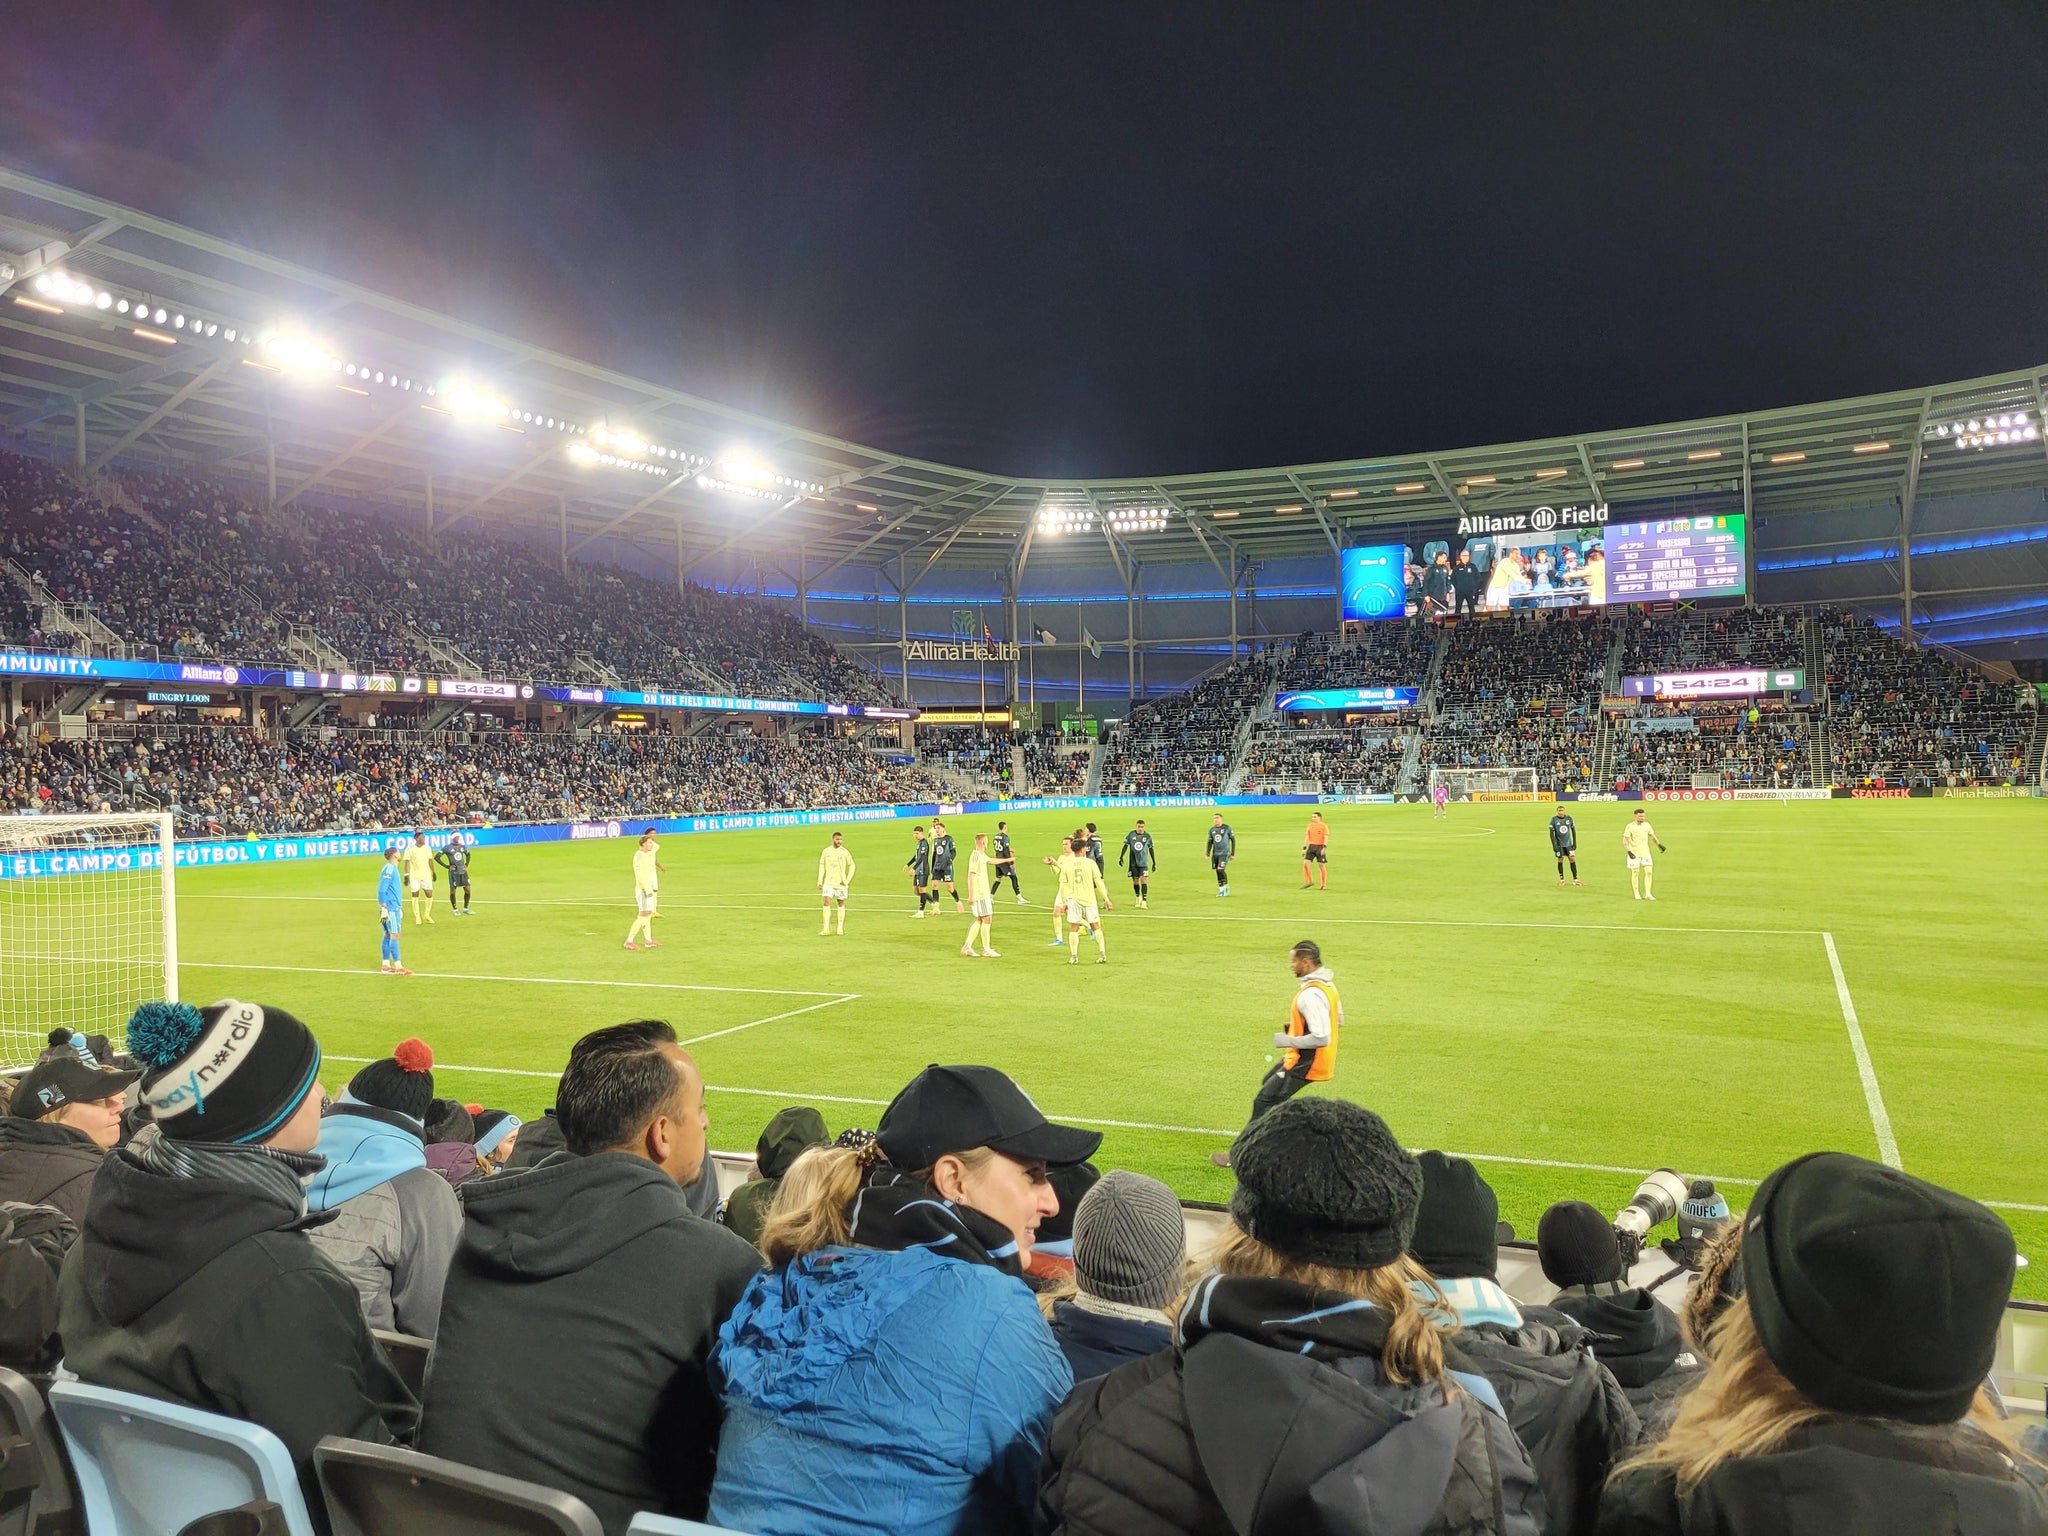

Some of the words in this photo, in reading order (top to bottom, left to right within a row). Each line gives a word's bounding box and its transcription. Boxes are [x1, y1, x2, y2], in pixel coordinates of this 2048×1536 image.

[1457, 514, 1527, 534] Allianz
[1561, 503, 1609, 525] Field
[908, 641, 962, 661] Allina
[182, 665, 223, 682] Allianz
[1634, 681, 1644, 693] 1
[1671, 678, 1750, 690] 54:24
[1775, 674, 1796, 687] 0
[455, 684, 507, 697] 54:24
[571, 690, 594, 701] Allianz
[148, 692, 185, 703] HUNGRY
[186, 693, 211, 703] LOON
[643, 694, 658, 704] ON
[660, 695, 677, 705] THE
[680, 695, 703, 707] FIELD
[705, 697, 722, 708] AND
[724, 698, 734, 708] IN
[735, 699, 752, 709] OUR
[753, 700, 801, 712] COMMUNITY.
[1480, 791, 1525, 802] Continental
[1577, 792, 1619, 803] Gillette
[1736, 792, 1776, 800] FEDERATED
[1776, 790, 1821, 799] INSURANCE
[1851, 788, 1911, 799] SEATGEEK
[1943, 788, 1976, 799] Allina
[1976, 787, 2015, 798] Health
[1032, 800, 1042, 809] DE
[1082, 799, 1090, 807] Y
[1092, 798, 1105, 807] EN
[1108, 797, 1152, 807] NUESTRA
[1154, 796, 1219, 807] COMUNIDAD.
[693, 819, 707, 831] EN
[709, 818, 720, 830] EL
[723, 816, 754, 829] CAMPO
[756, 816, 767, 826] DE
[769, 811, 800, 825] FÚTBOL
[801, 813, 808, 823] Y
[810, 812, 821, 823] EN
[822, 810, 855, 823] NUESTRA
[855, 809, 898, 820] COMUNIDAD.
[572, 823, 608, 839] Allianz
[993, 839, 1005, 852] 26
[15, 858, 42, 875] EL
[51, 853, 132, 872] CAMPO
[174, 845, 250, 865] FÚTBOL
[256, 847, 269, 860] Y
[274, 844, 299, 859] EN
[304, 838, 381, 856] NUESTRA
[1074, 868, 1084, 884] 5
